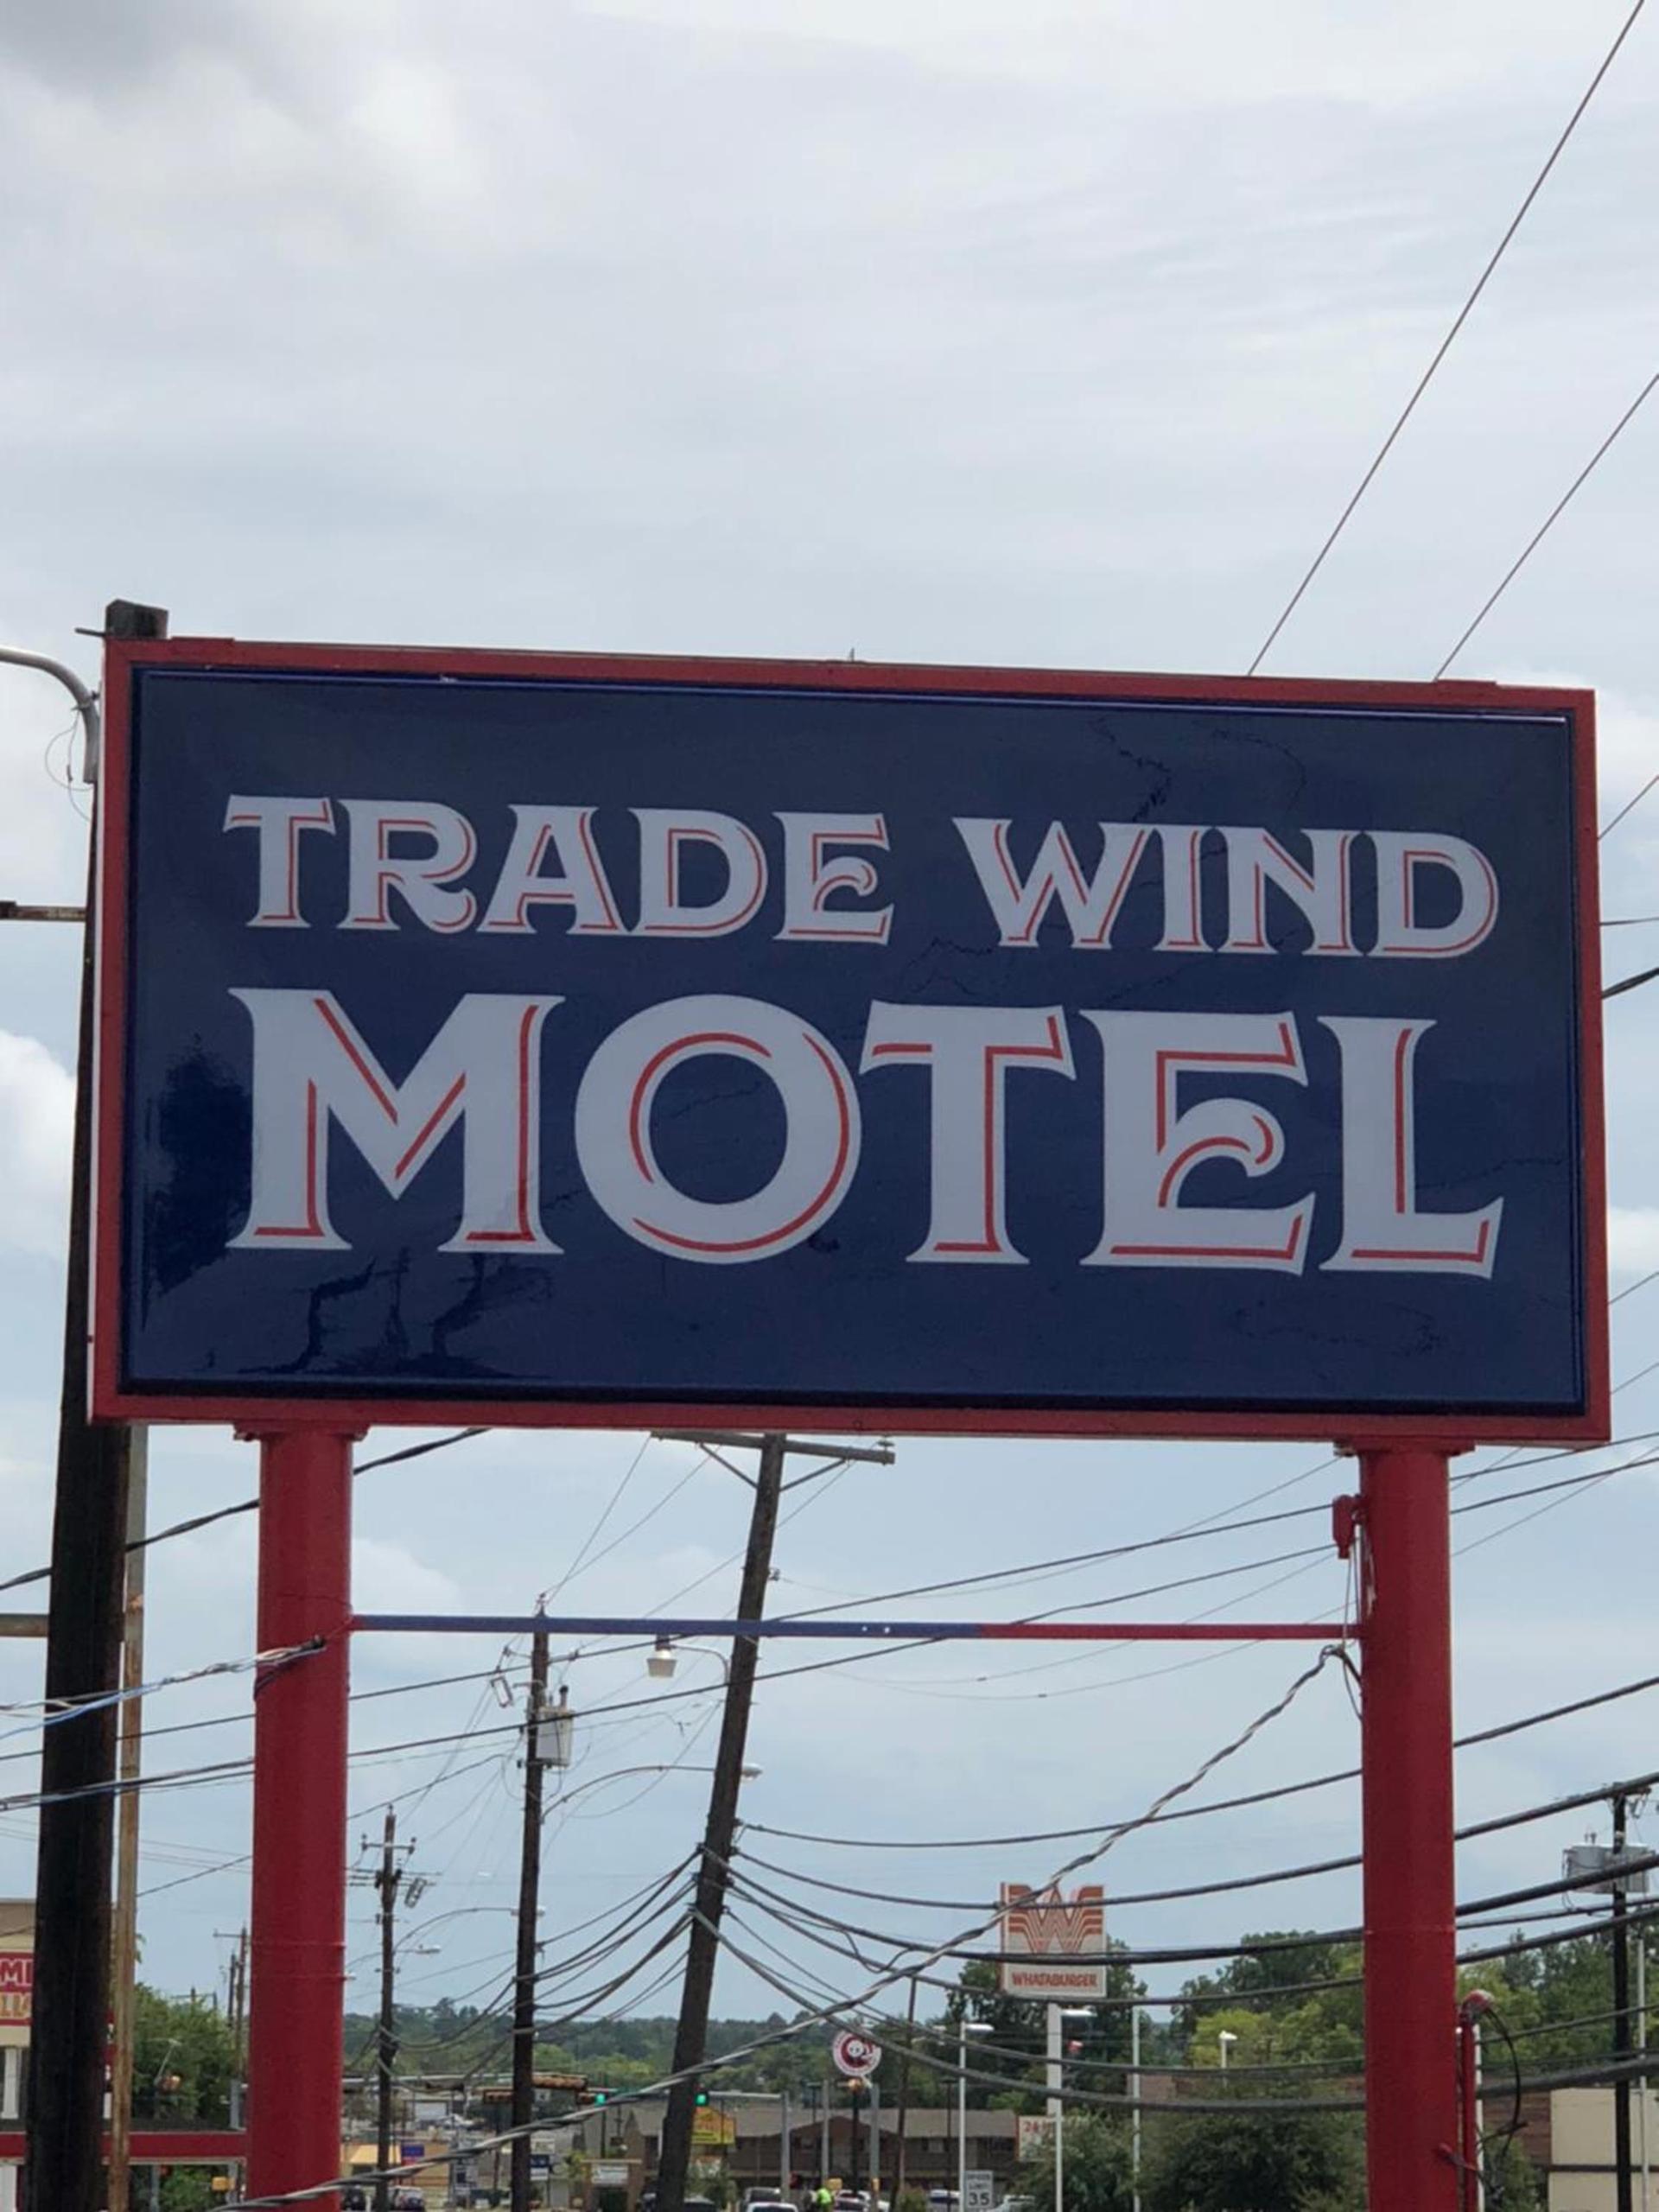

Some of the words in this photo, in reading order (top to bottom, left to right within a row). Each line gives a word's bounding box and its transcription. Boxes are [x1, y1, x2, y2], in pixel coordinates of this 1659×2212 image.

[224, 796, 893, 944] TRADE
[953, 817, 1499, 959] WIND
[229, 988, 1503, 1280] MOTEL
[1012, 1973, 1098, 1987] WHATABURGER
[969, 2192, 990, 2206] 35
